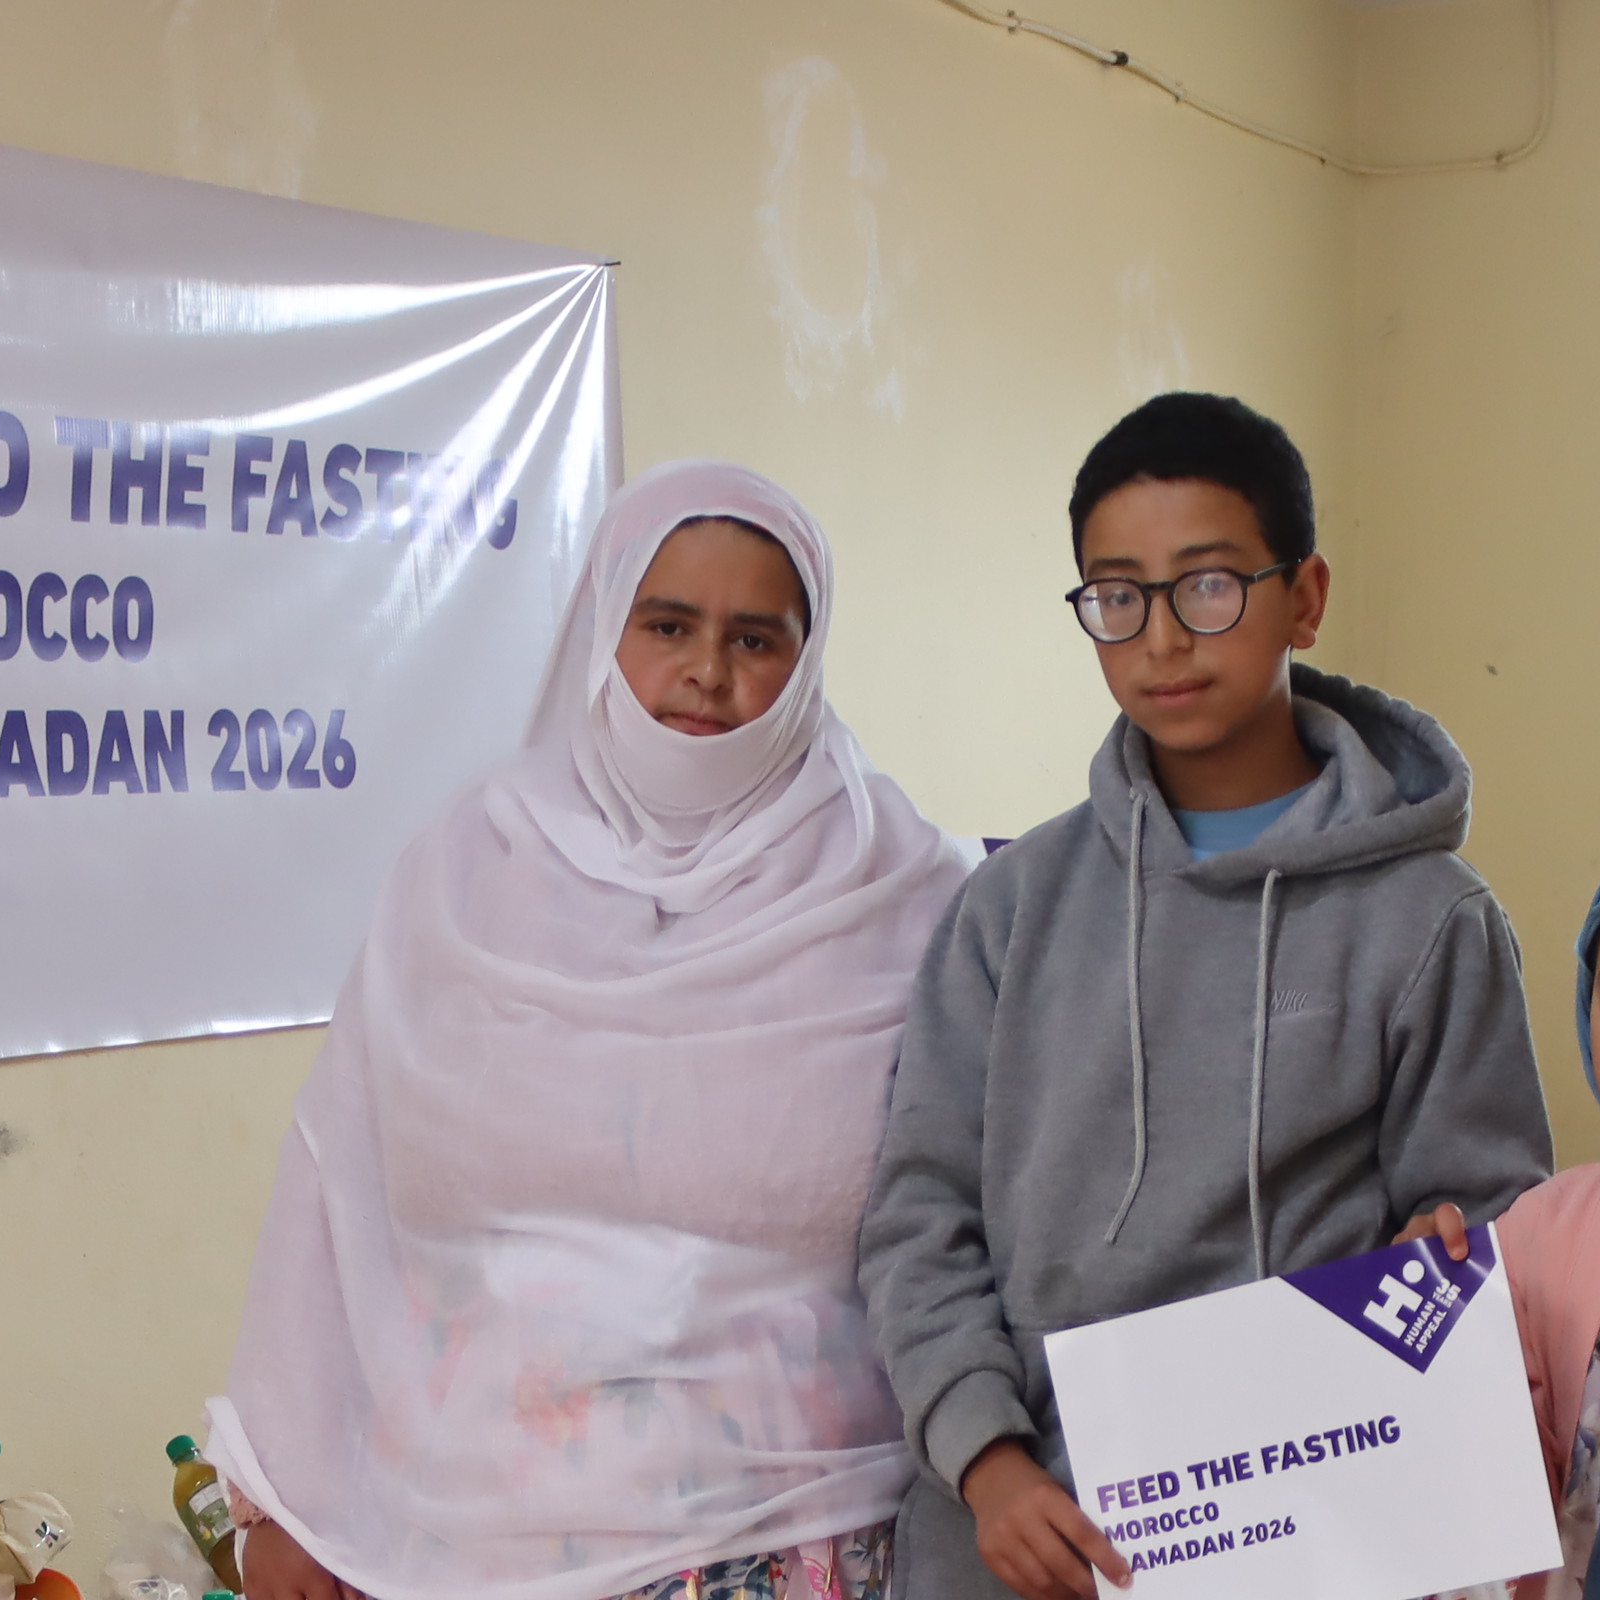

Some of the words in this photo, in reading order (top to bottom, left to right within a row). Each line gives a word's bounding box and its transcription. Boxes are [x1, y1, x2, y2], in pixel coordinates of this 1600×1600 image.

[55, 415, 207, 530] THE
[208, 707, 357, 793] 2026
[1403, 1300, 1436, 1346] HUMAN
[1415, 1309, 1448, 1354] APPEAL
[1097, 1469, 1182, 1513] FEED
[1187, 1453, 1255, 1491] THE
[1260, 1415, 1403, 1475] FASTING
[1102, 1501, 1221, 1544] MOROCCO
[1127, 1530, 1236, 1573] AMADAN
[1241, 1516, 1298, 1550] 2026
